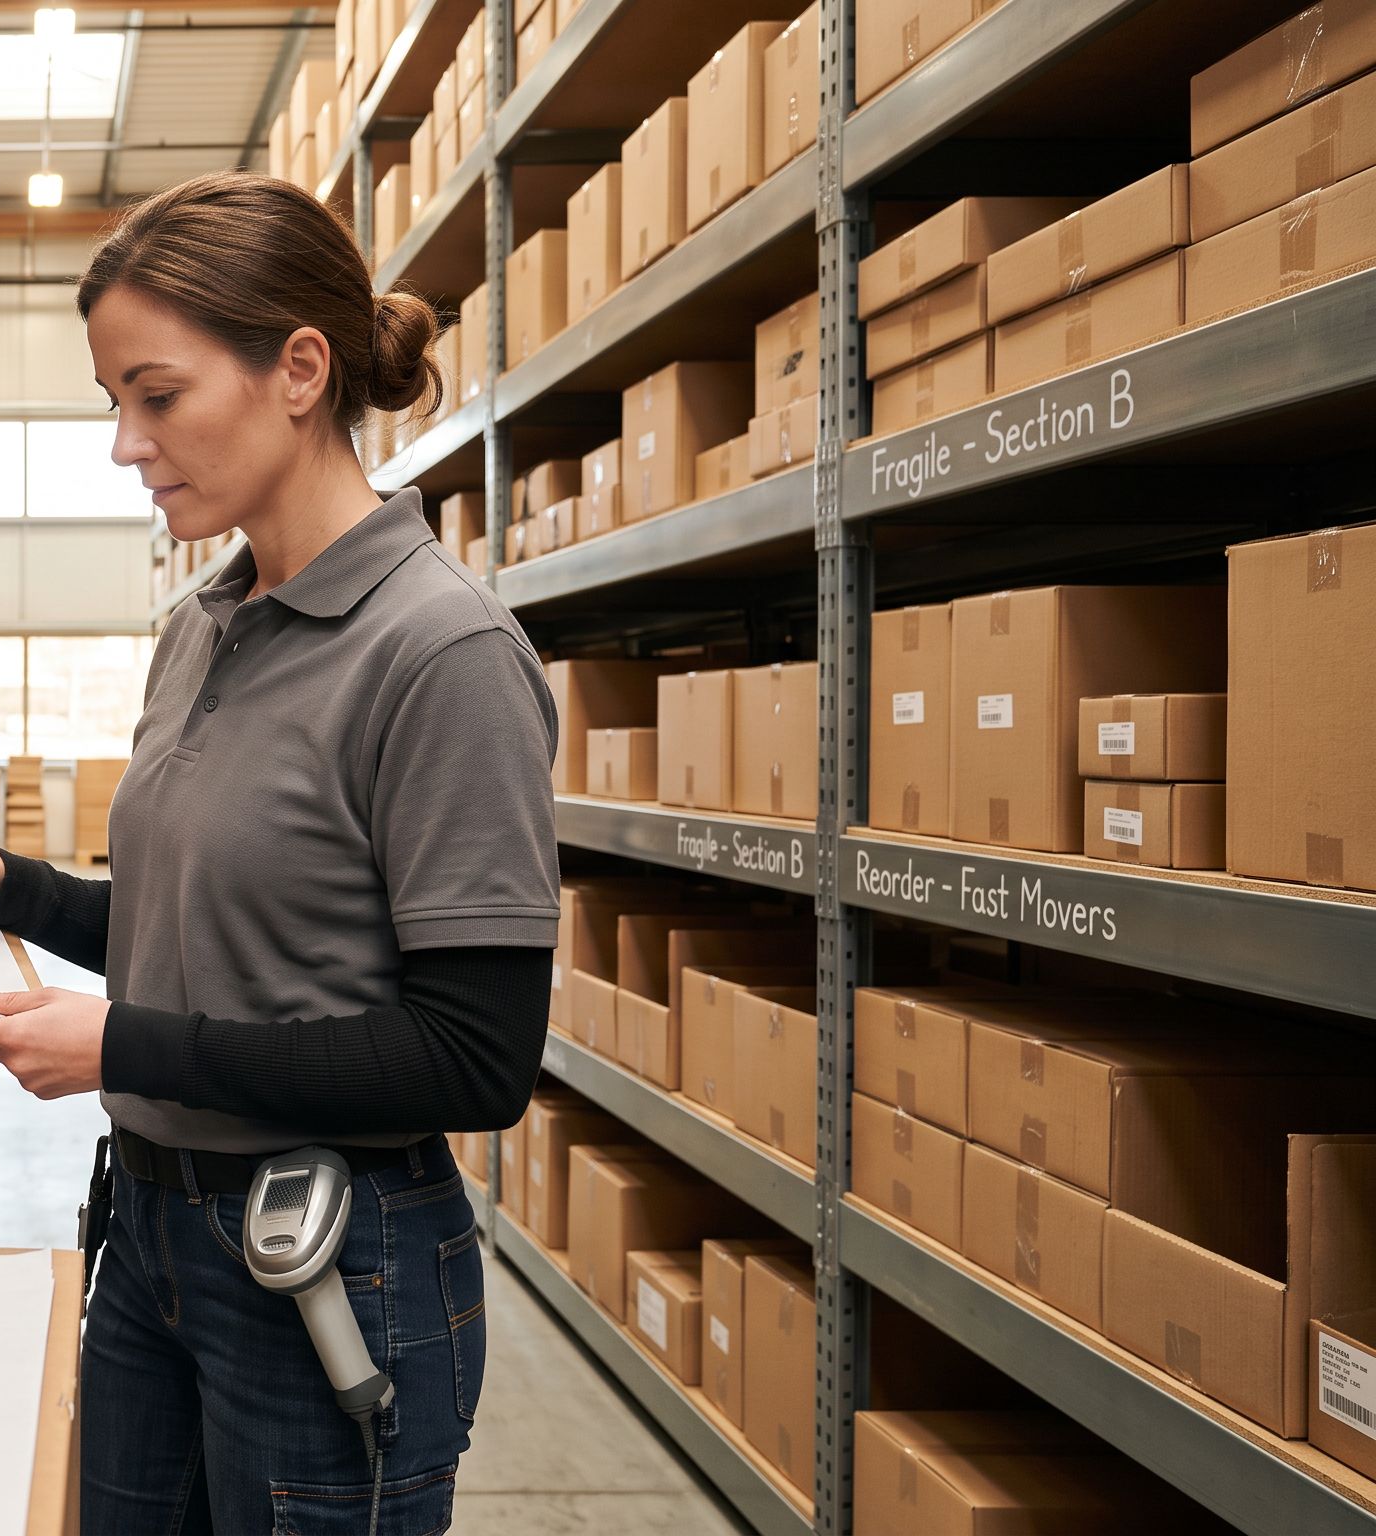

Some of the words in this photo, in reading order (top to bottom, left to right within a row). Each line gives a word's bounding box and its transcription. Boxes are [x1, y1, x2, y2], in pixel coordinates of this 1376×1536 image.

[870, 431, 952, 498] Fragile
[984, 409, 1096, 465] Section
[1110, 368, 1135, 429] B
[677, 823, 718, 870] Fragile
[732, 831, 785, 875] Section
[790, 838, 804, 879] B
[856, 850, 934, 904] Reorder
[960, 866, 1010, 920] Fast
[1020, 874, 1117, 941] Movers
